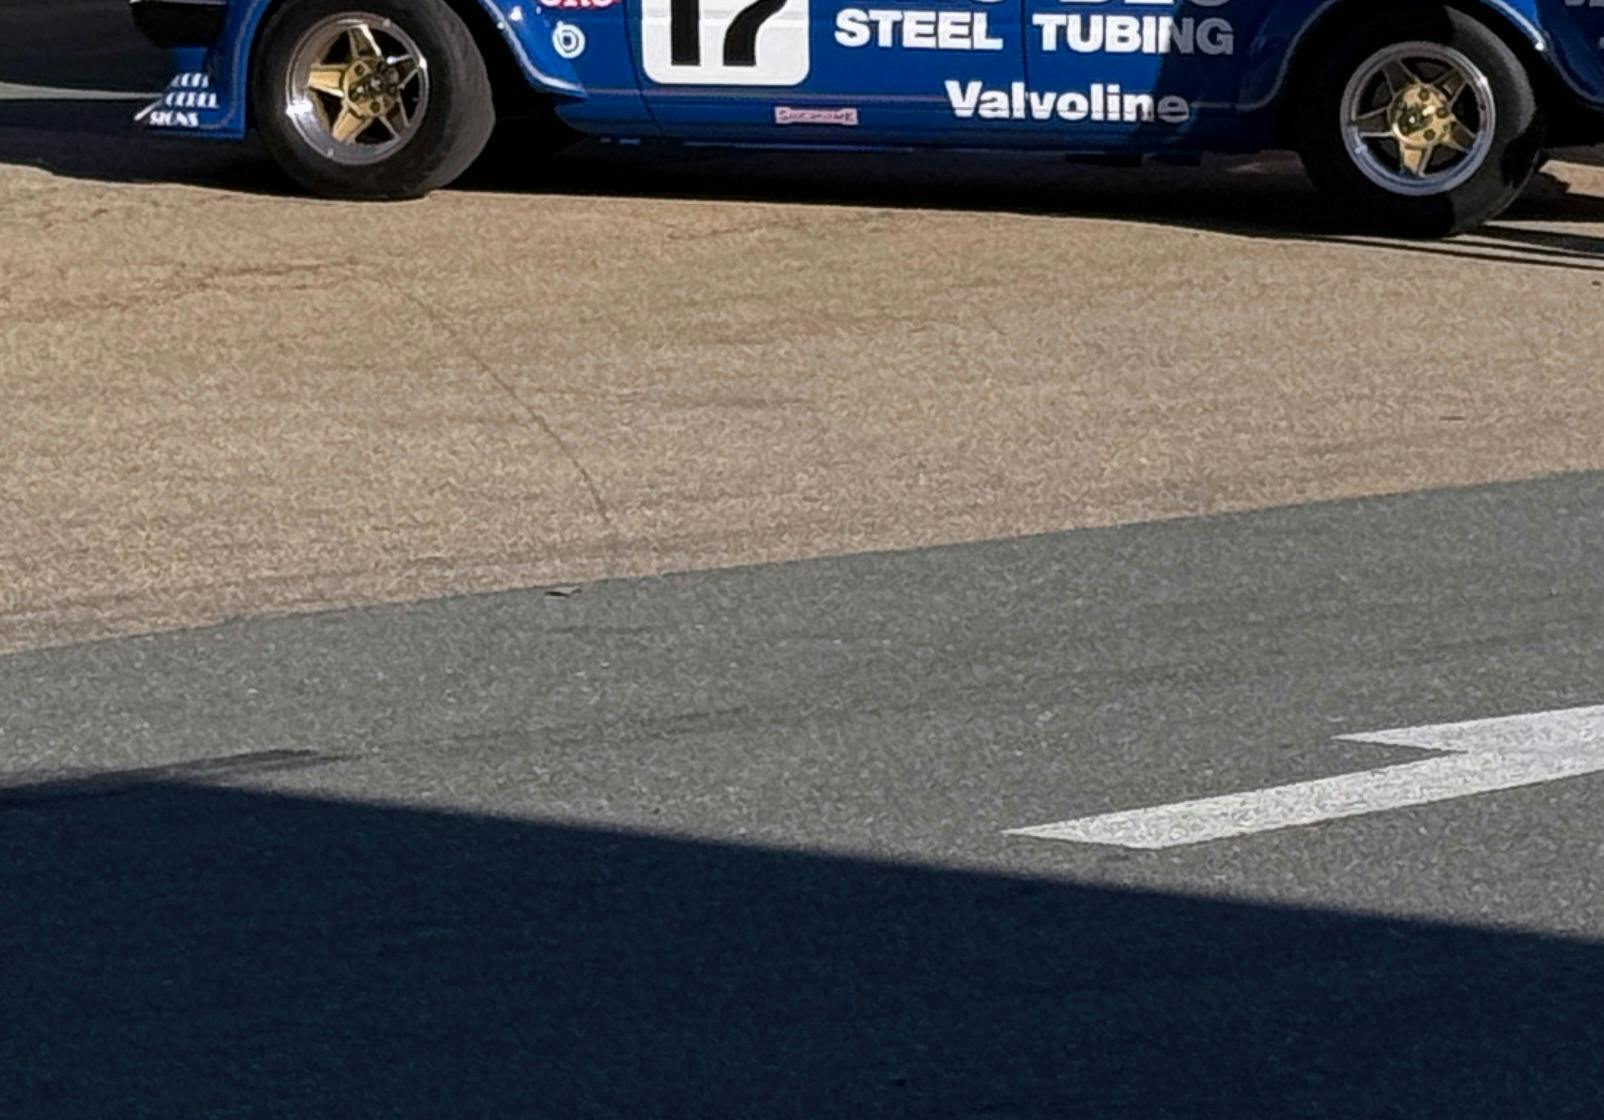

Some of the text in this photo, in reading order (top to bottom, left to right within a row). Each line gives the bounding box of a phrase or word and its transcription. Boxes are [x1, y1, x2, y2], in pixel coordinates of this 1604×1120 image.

[834, 8, 1234, 56] STEEL TUBING
[944, 79, 1190, 124] Valvoline
